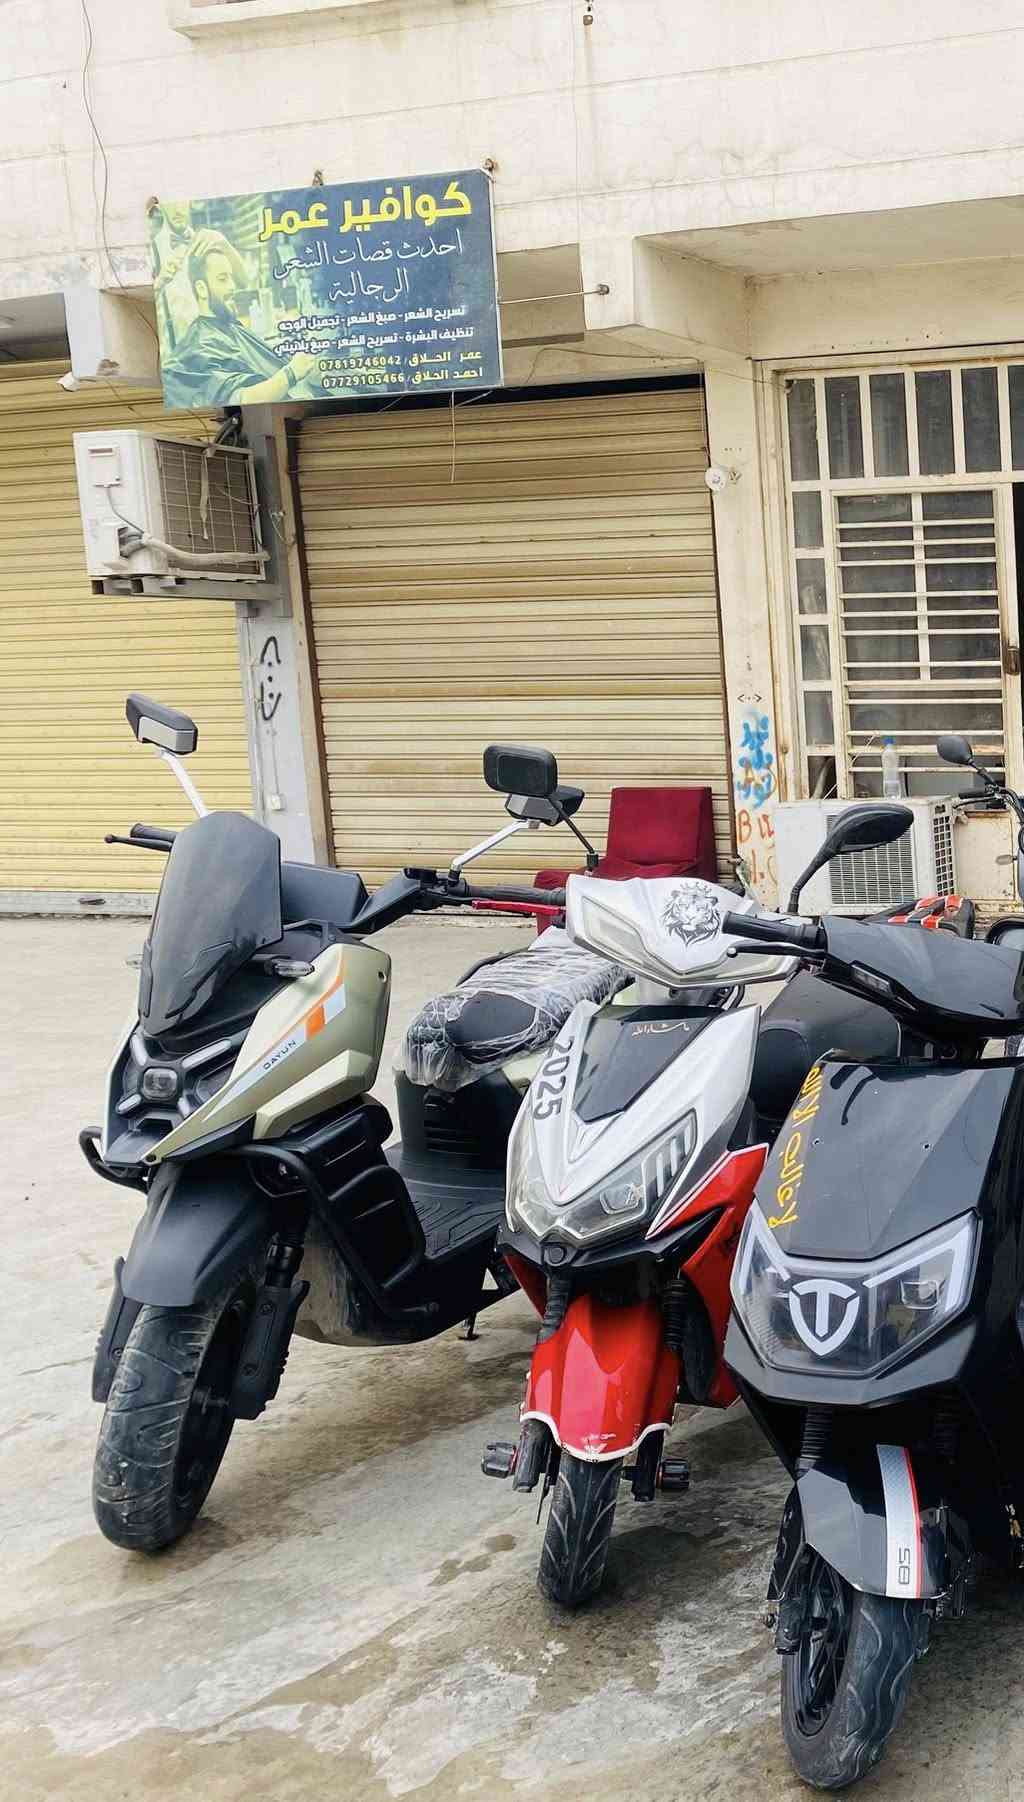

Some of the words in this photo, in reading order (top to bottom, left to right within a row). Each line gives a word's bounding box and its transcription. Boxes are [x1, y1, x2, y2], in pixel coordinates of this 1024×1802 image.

[259, 206, 328, 242] عمر
[339, 180, 472, 233] كوافير
[273, 240, 329, 279] الشعر
[332, 236, 393, 264] قصات
[397, 228, 463, 259] احدث
[329, 267, 409, 304] الرجالية
[533, 1037, 575, 1121] 2025
